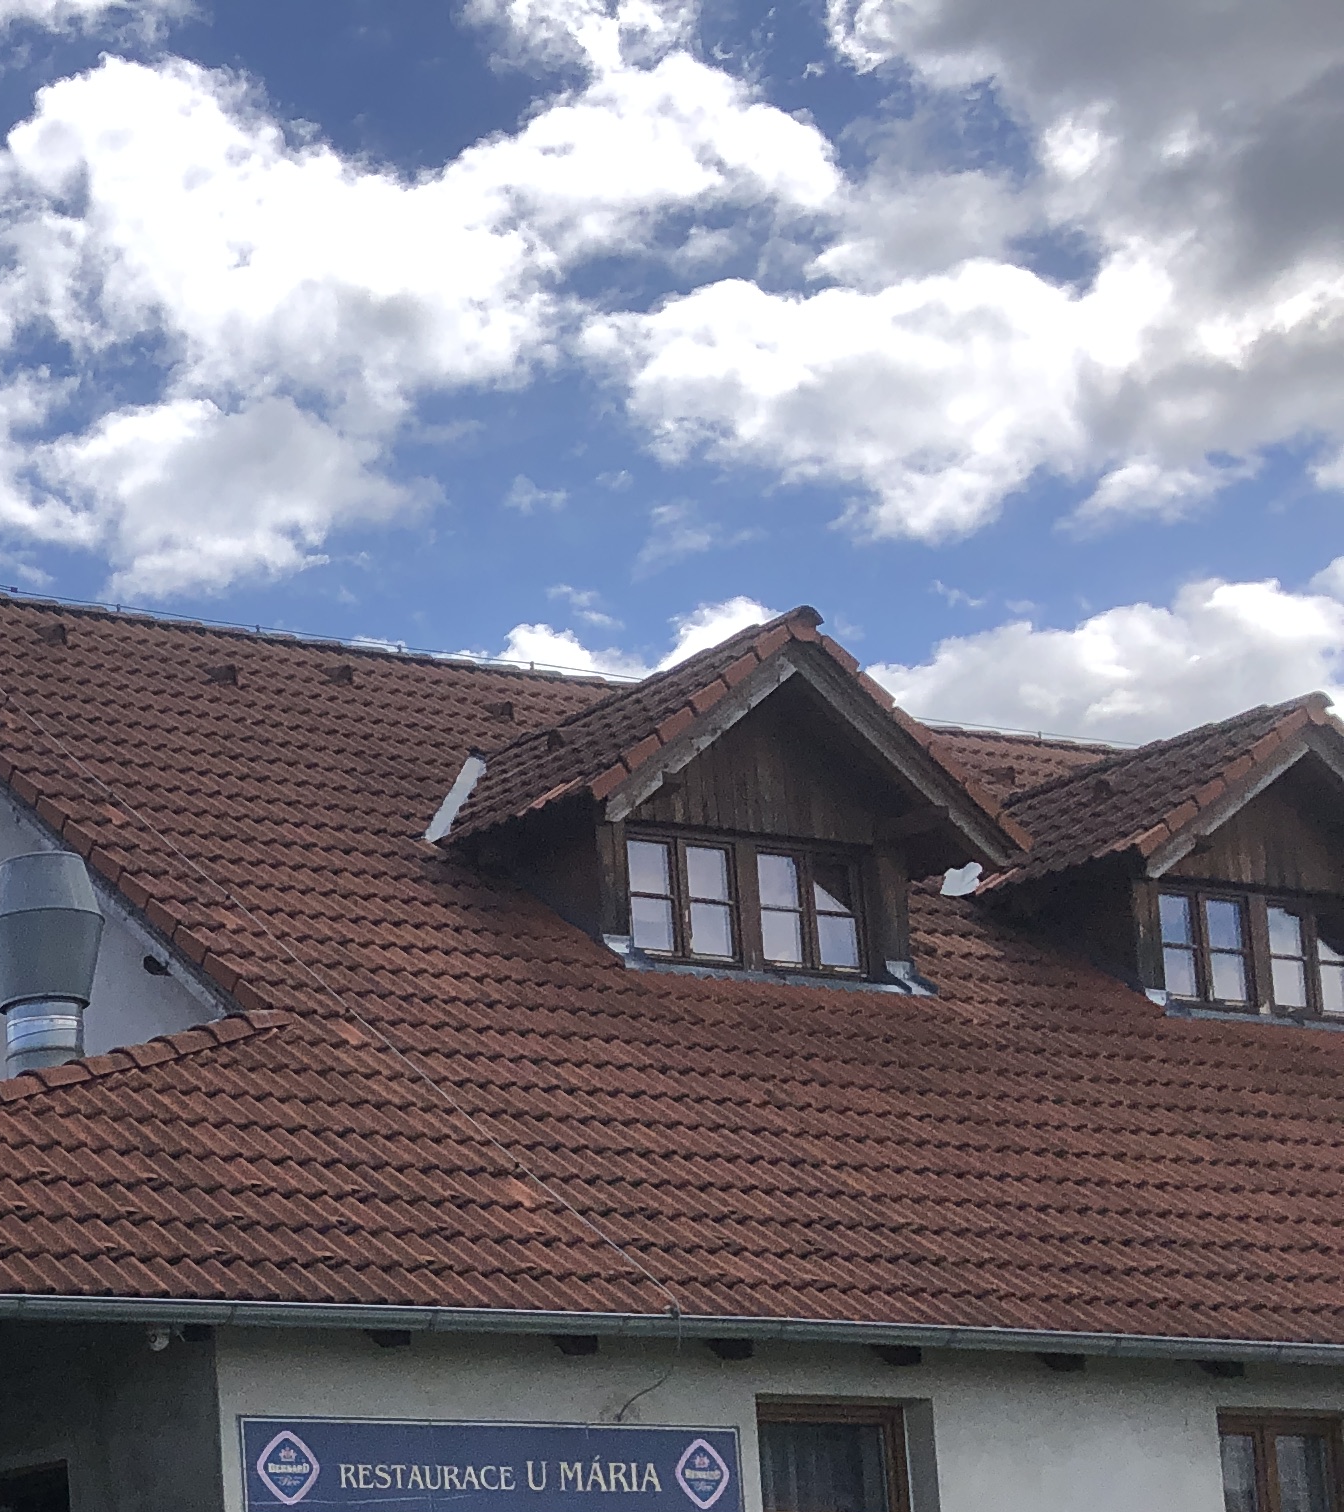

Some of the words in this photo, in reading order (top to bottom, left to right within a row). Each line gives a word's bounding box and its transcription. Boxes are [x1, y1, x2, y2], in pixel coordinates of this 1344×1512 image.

[339, 1462, 514, 1490] RESTAURACE
[526, 1461, 548, 1491] U
[559, 1455, 662, 1493] MÁRIA
